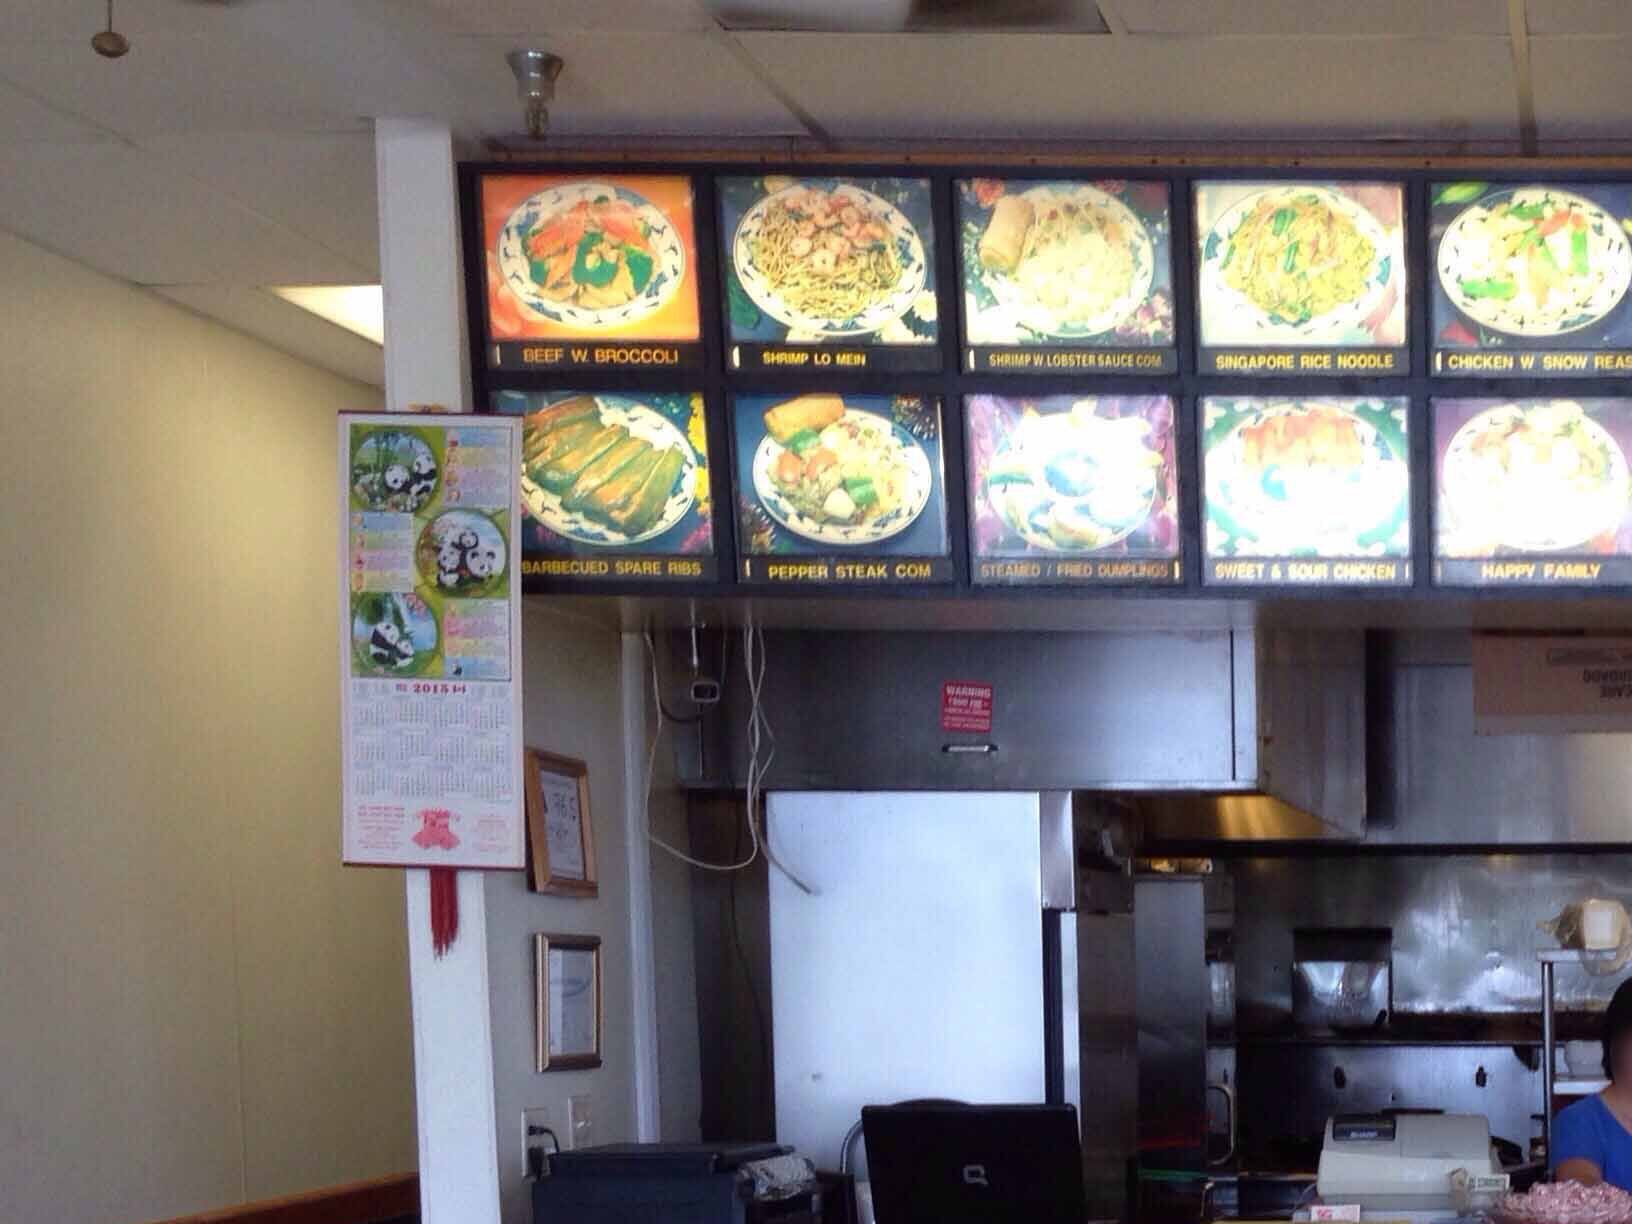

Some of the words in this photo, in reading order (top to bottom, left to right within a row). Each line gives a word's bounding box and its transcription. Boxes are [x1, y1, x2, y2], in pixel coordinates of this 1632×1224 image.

[523, 348, 564, 363] BEEF
[594, 348, 678, 364] BROCCOLI
[763, 352, 808, 366] SHRIMP
[814, 352, 831, 366] LO
[836, 352, 866, 366] MEIN
[989, 353, 1032, 368] SHRIMP
[1047, 353, 1097, 368] LOBSTER
[1097, 353, 1134, 368] SAUCE
[1215, 354, 1295, 370] SINGAPORE
[1300, 354, 1331, 369] RICE
[1337, 354, 1394, 369] NOODLE
[1448, 354, 1513, 369] CHICKEN
[1543, 354, 1588, 369] SNOW
[522, 560, 609, 575] BARBECUED
[615, 560, 662, 576] SPARE
[668, 560, 702, 576] RIBS
[768, 564, 829, 580] PEPPER
[836, 564, 887, 579] STEAK
[895, 563, 931, 579] COM
[981, 563, 1041, 577] STEAMED
[1215, 563, 1265, 579] SWEET
[1287, 563, 1329, 579] SOUR
[1333, 563, 1396, 579] CHICKEN
[1482, 563, 1535, 579] HAPPY
[1543, 563, 1600, 579] FAMILY
[946, 685, 992, 698] WARNING
